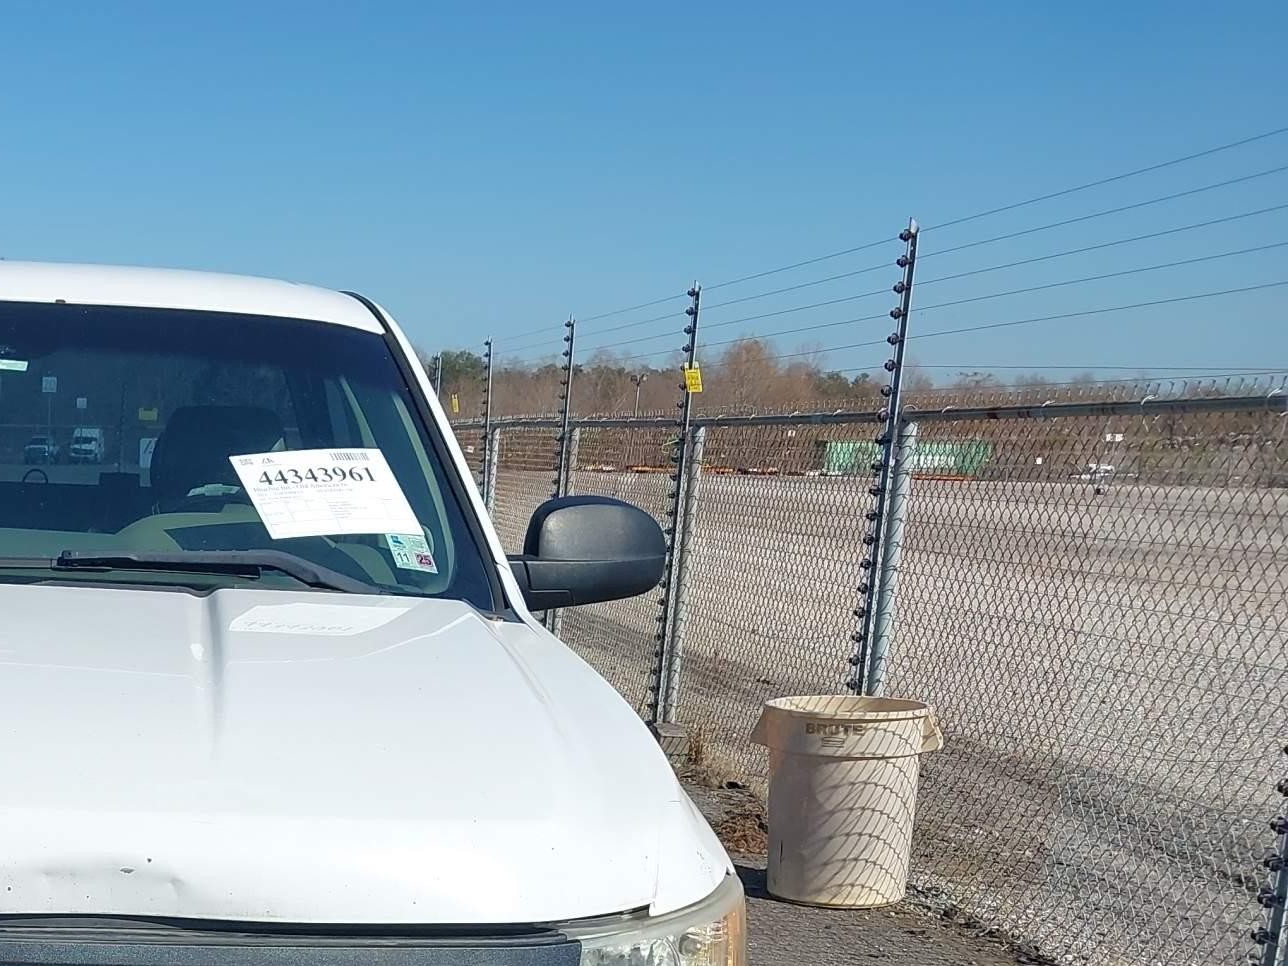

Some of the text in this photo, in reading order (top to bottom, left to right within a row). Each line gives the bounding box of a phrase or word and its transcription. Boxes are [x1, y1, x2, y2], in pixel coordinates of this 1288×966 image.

[258, 466, 377, 486] 44343961
[397, 552, 410, 563] 11
[416, 553, 432, 566] 25
[805, 723, 865, 736] BRUTE
